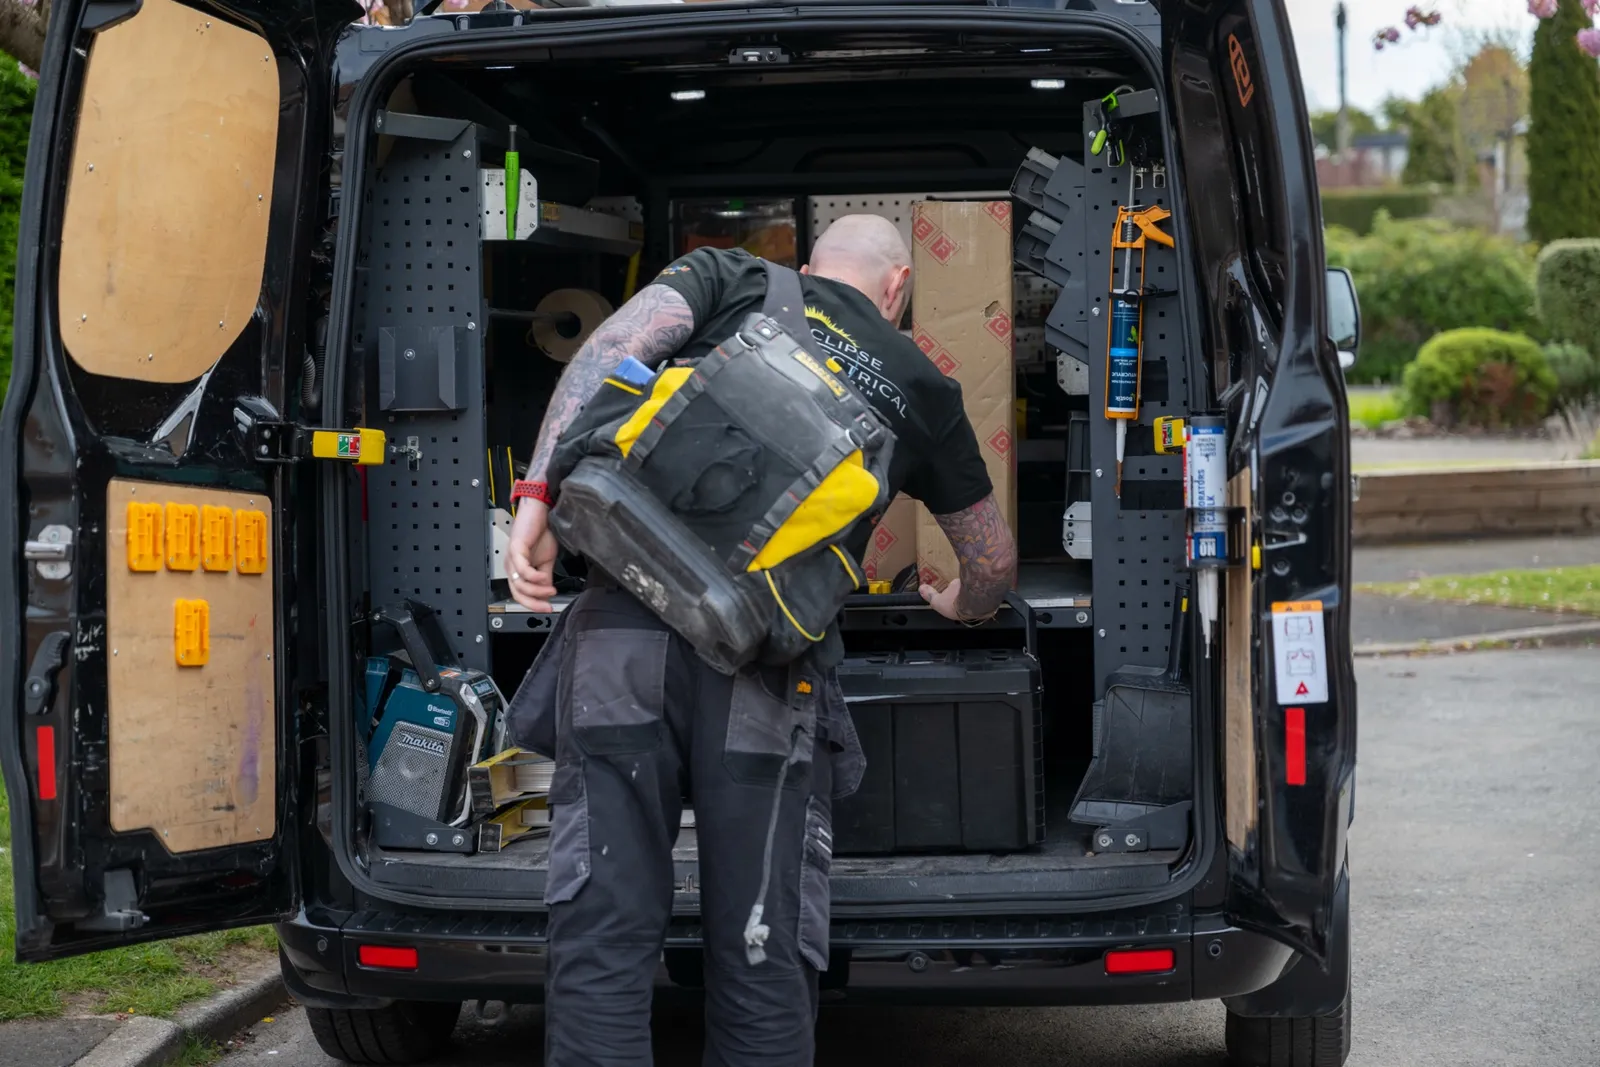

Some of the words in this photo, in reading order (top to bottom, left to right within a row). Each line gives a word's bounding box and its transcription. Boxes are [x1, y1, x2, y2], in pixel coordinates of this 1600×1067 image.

[810, 328, 883, 371] CLIPSE
[823, 351, 907, 419] CTRICAL
[1199, 541, 1216, 557] NO
